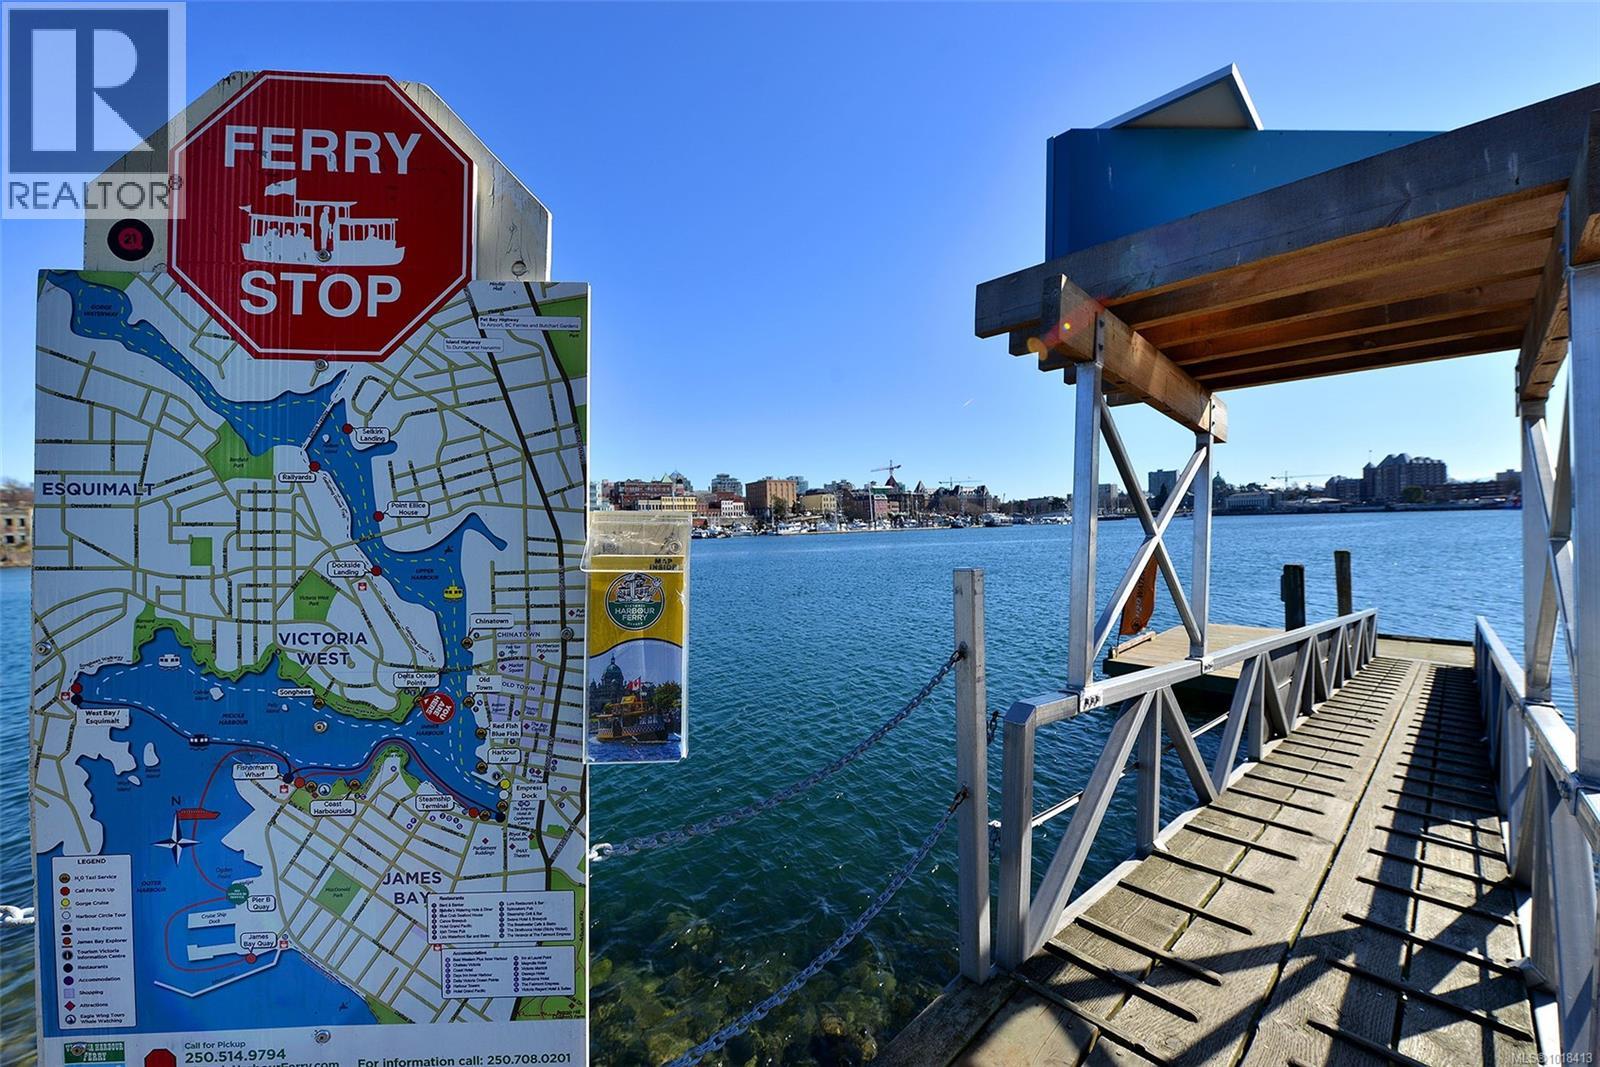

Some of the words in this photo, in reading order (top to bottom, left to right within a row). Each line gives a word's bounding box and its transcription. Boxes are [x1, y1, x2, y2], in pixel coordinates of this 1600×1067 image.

[225, 125, 421, 174] FERRY
[240, 272, 402, 318] STOP
[42, 482, 155, 496] ESQUIMALT
[279, 632, 367, 645] VICTORIA
[298, 652, 350, 665] WEST
[516, 682, 536, 691] TOWN
[426, 696, 440, 715] HERE
[434, 700, 445, 716] ARE
[440, 705, 451, 720] YOU
[172, 796, 181, 805] N
[382, 872, 442, 885] JAMES
[394, 892, 430, 904] BAY
[217, 1041, 246, 1050] Pickup
[185, 1049, 286, 1064] 250.514.9794
[358, 1059, 379, 1067] For
[383, 1056, 454, 1067] information
[459, 1056, 483, 1066] call:
[487, 1053, 571, 1065] 250.708.0201
